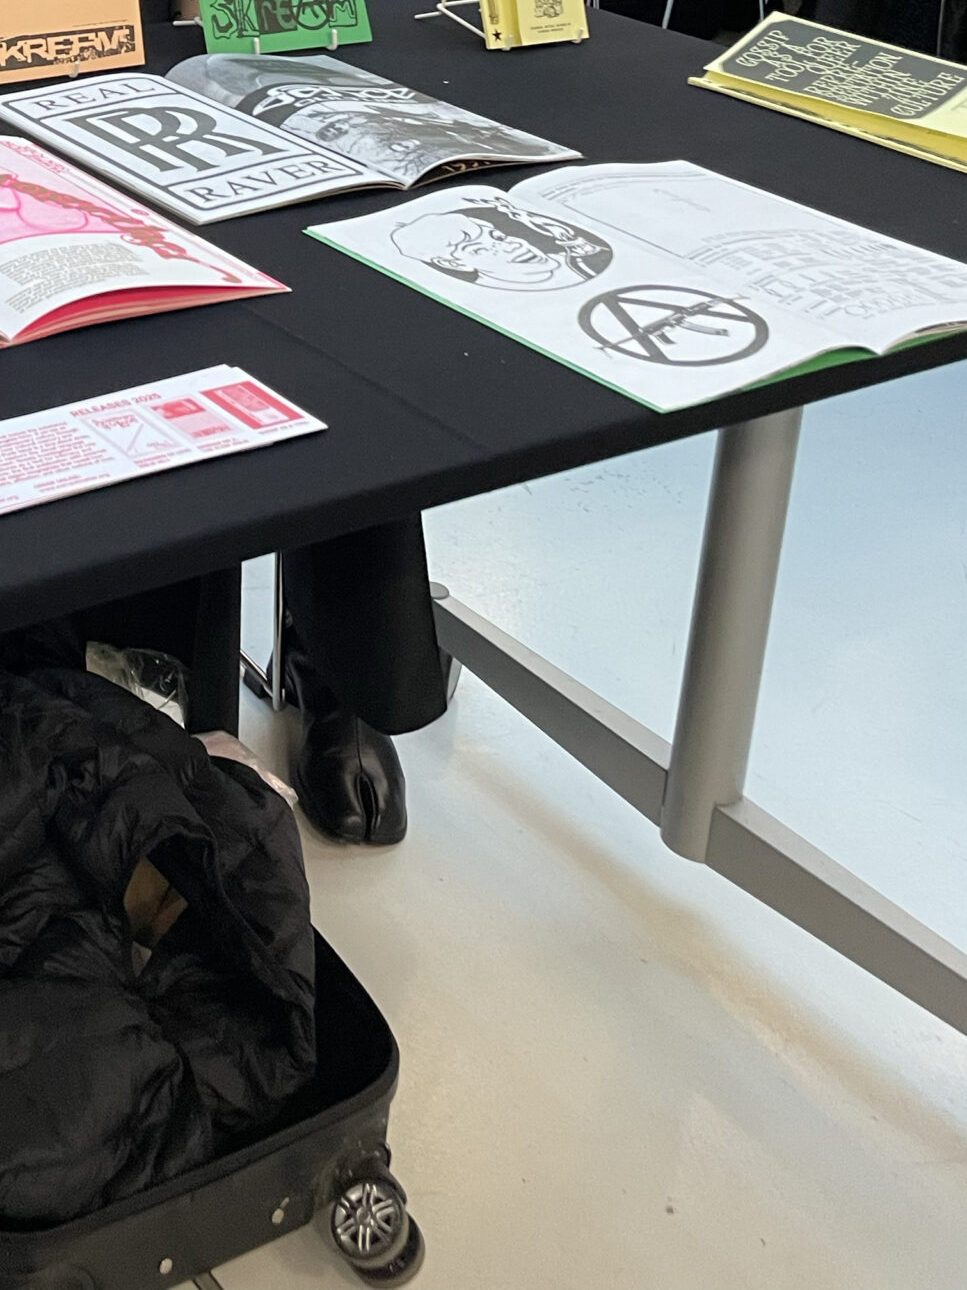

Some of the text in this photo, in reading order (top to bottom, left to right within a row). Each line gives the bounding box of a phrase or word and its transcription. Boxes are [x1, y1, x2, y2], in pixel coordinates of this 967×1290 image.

[736, 29, 789, 67] GOSSIP
[798, 36, 840, 58] FOR
[806, 41, 862, 74] QUEER
[34, 83, 156, 111] REAL
[890, 72, 966, 117] CULTURE
[184, 158, 347, 202] RAVER
[70, 398, 131, 417] RELEASES
